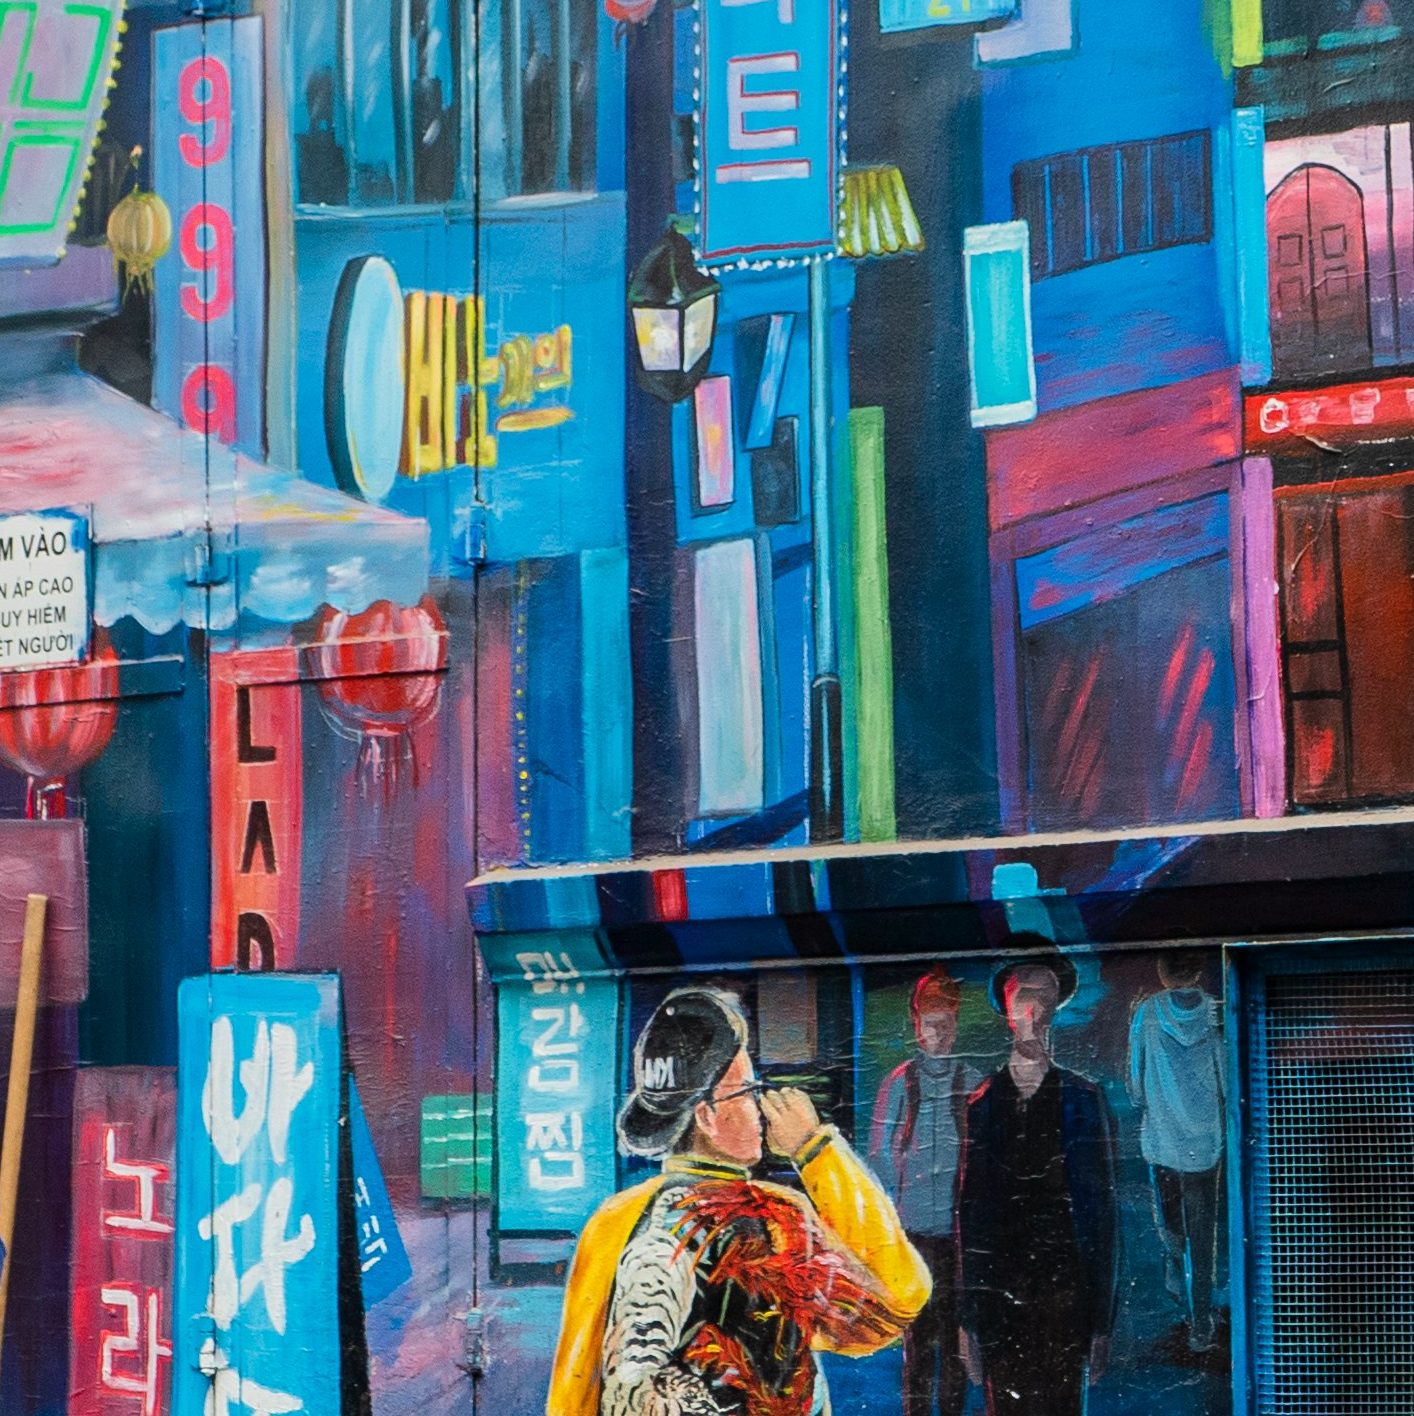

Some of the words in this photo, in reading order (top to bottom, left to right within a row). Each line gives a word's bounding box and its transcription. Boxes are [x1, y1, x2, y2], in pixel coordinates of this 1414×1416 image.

[21, 526, 67, 559] VÀO
[12, 576, 34, 599] ÁP
[38, 576, 74, 596] CAO
